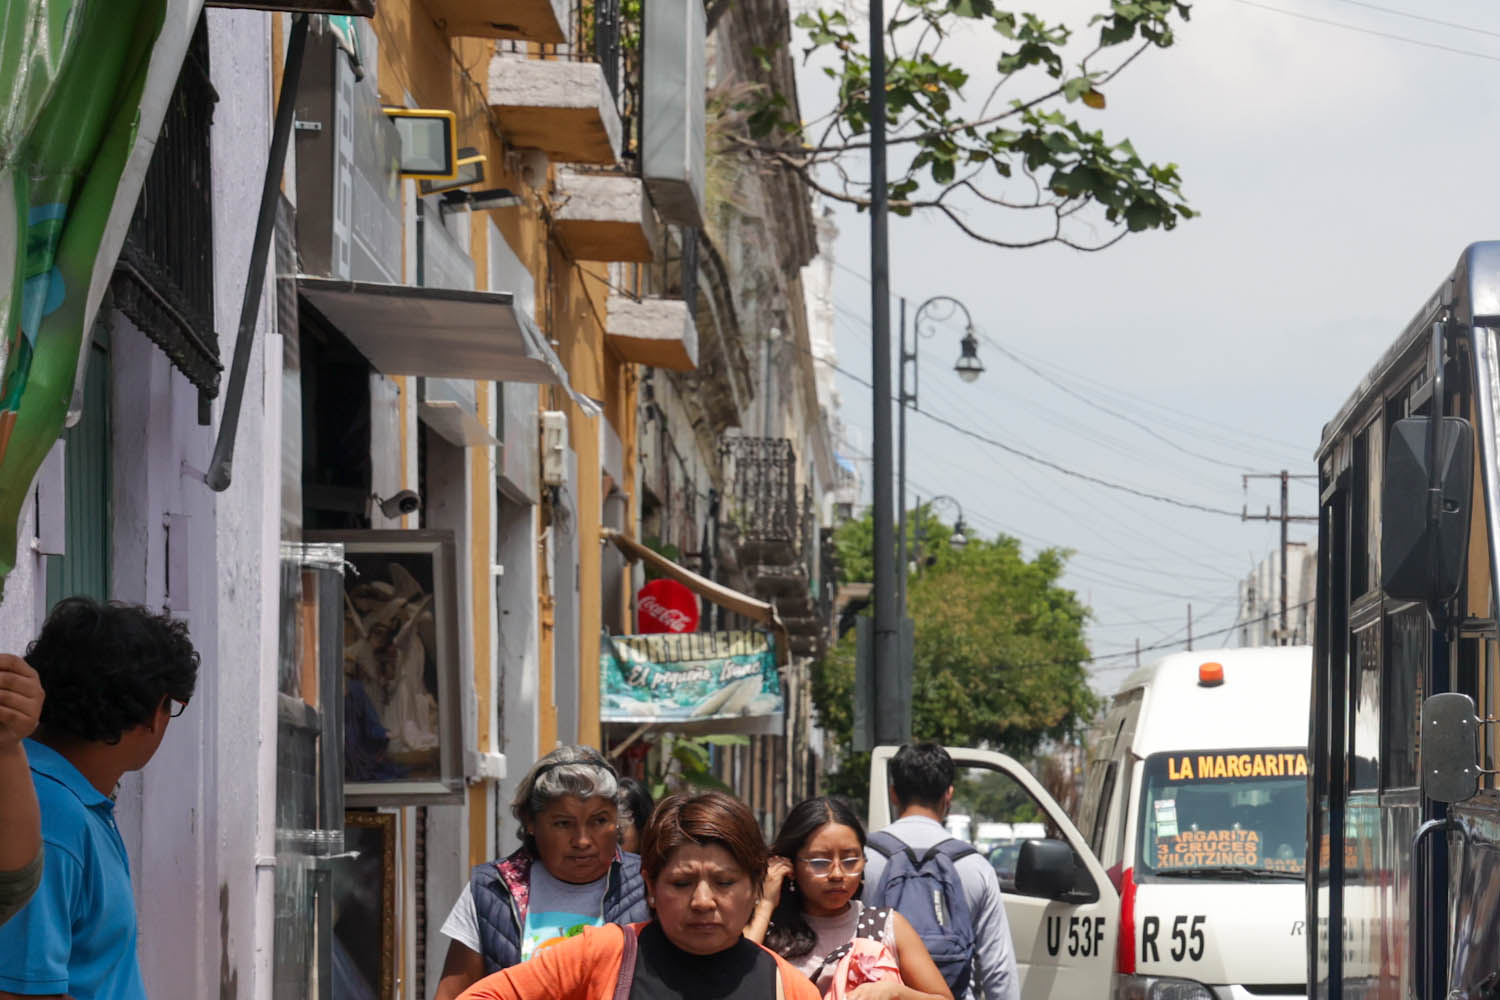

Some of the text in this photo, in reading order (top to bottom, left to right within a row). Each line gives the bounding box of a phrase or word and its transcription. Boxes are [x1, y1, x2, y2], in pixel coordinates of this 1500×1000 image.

[1168, 753, 1308, 780] LA MARGARITA
[1158, 841, 1257, 854] 3 CRUCES
[1047, 916, 1106, 957] U 53F
[1141, 915, 1207, 962] R 55
